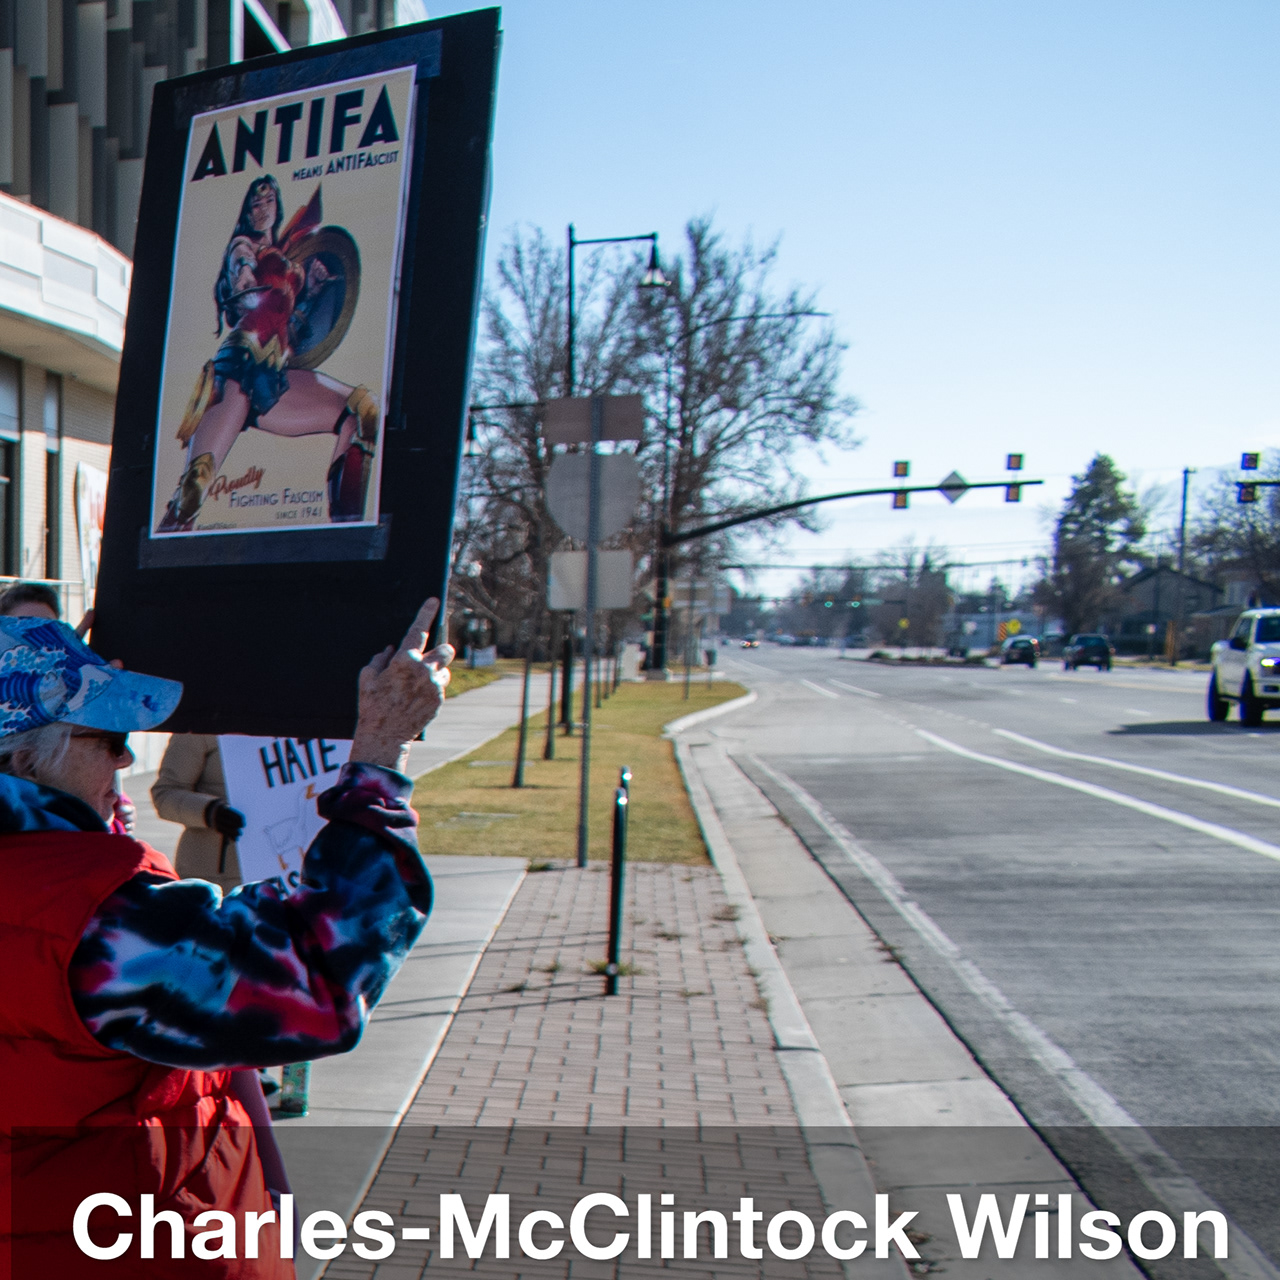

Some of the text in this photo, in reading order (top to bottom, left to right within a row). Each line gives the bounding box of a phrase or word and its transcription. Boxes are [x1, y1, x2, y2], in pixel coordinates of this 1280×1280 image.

[191, 83, 400, 182] ANTIFA
[292, 164, 324, 181] MEANS
[208, 464, 267, 501] Proudly
[301, 506, 323, 518] 1941
[259, 737, 341, 789] HATE
